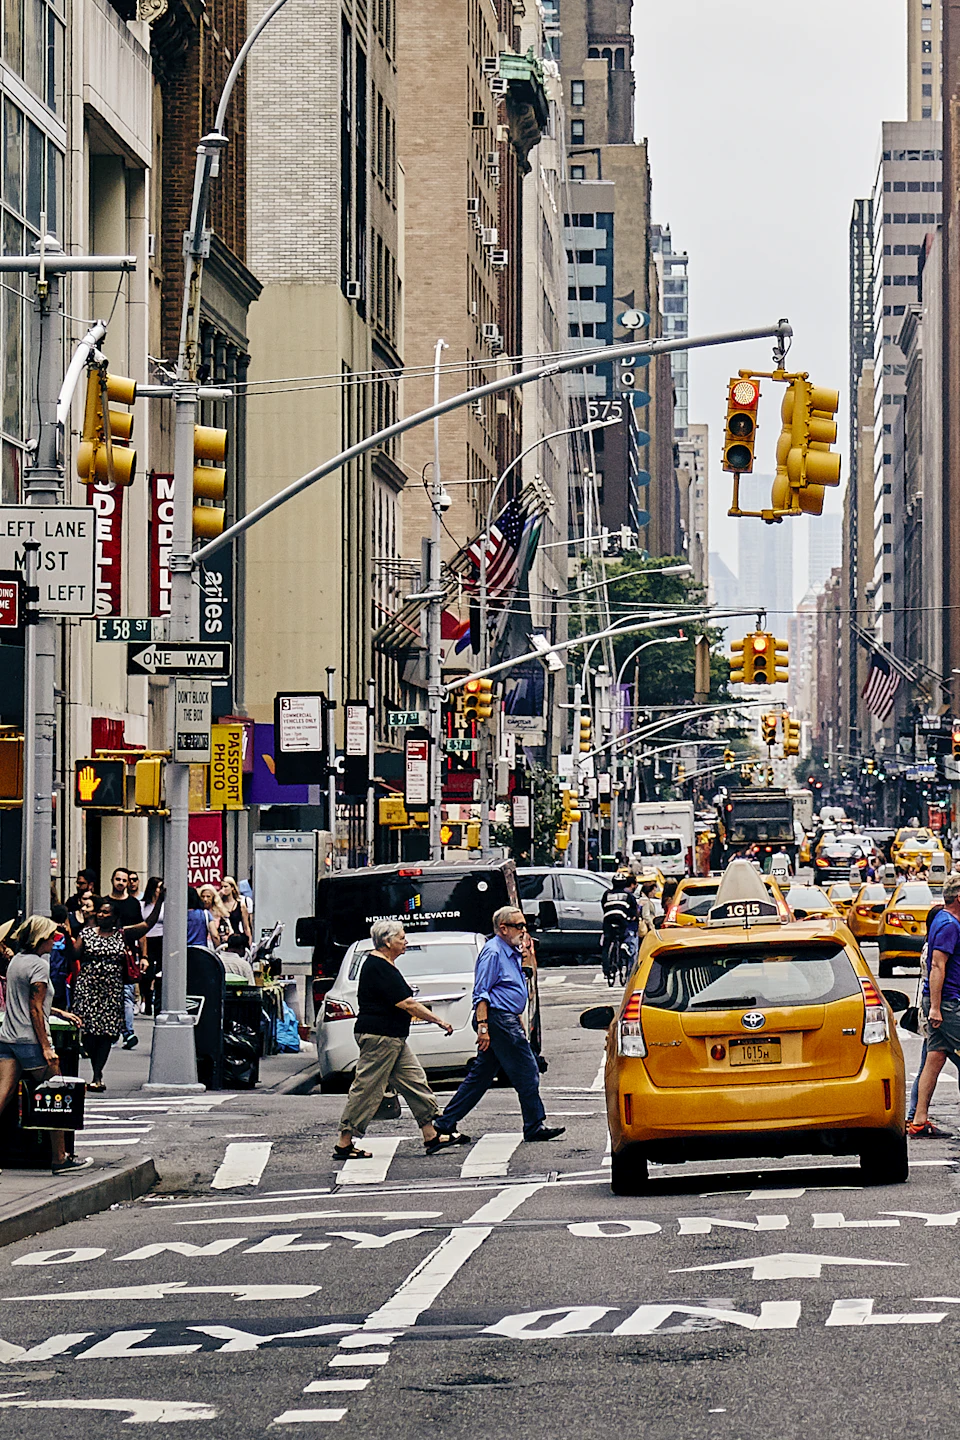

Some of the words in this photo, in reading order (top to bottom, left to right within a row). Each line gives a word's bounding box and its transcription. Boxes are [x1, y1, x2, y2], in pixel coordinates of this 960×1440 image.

[45, 521, 86, 537] LANE
[48, 584, 86, 601] LEFT
[99, 621, 106, 639] E
[112, 620, 130, 639] 58
[135, 620, 148, 631] ST
[143, 652, 171, 665] ONE
[186, 653, 217, 666] WAY
[192, 691, 209, 703] BLOCK
[282, 699, 290, 710] 3
[183, 709, 192, 721] THE
[193, 709, 203, 721] BOX
[390, 714, 395, 724] E
[398, 713, 408, 724] 57
[455, 739, 463, 750] 57
[213, 743, 226, 791] PHOTO
[227, 732, 240, 802] PASSPORT
[265, 835, 303, 843] Phone
[188, 840, 219, 855] 00%
[365, 913, 411, 923] NOUVEAU
[413, 910, 461, 920] ELEVATOR
[726, 903, 760, 918] 1G15
[741, 1045, 769, 1060] 1G15H
[10, 1227, 435, 1266] ONLY
